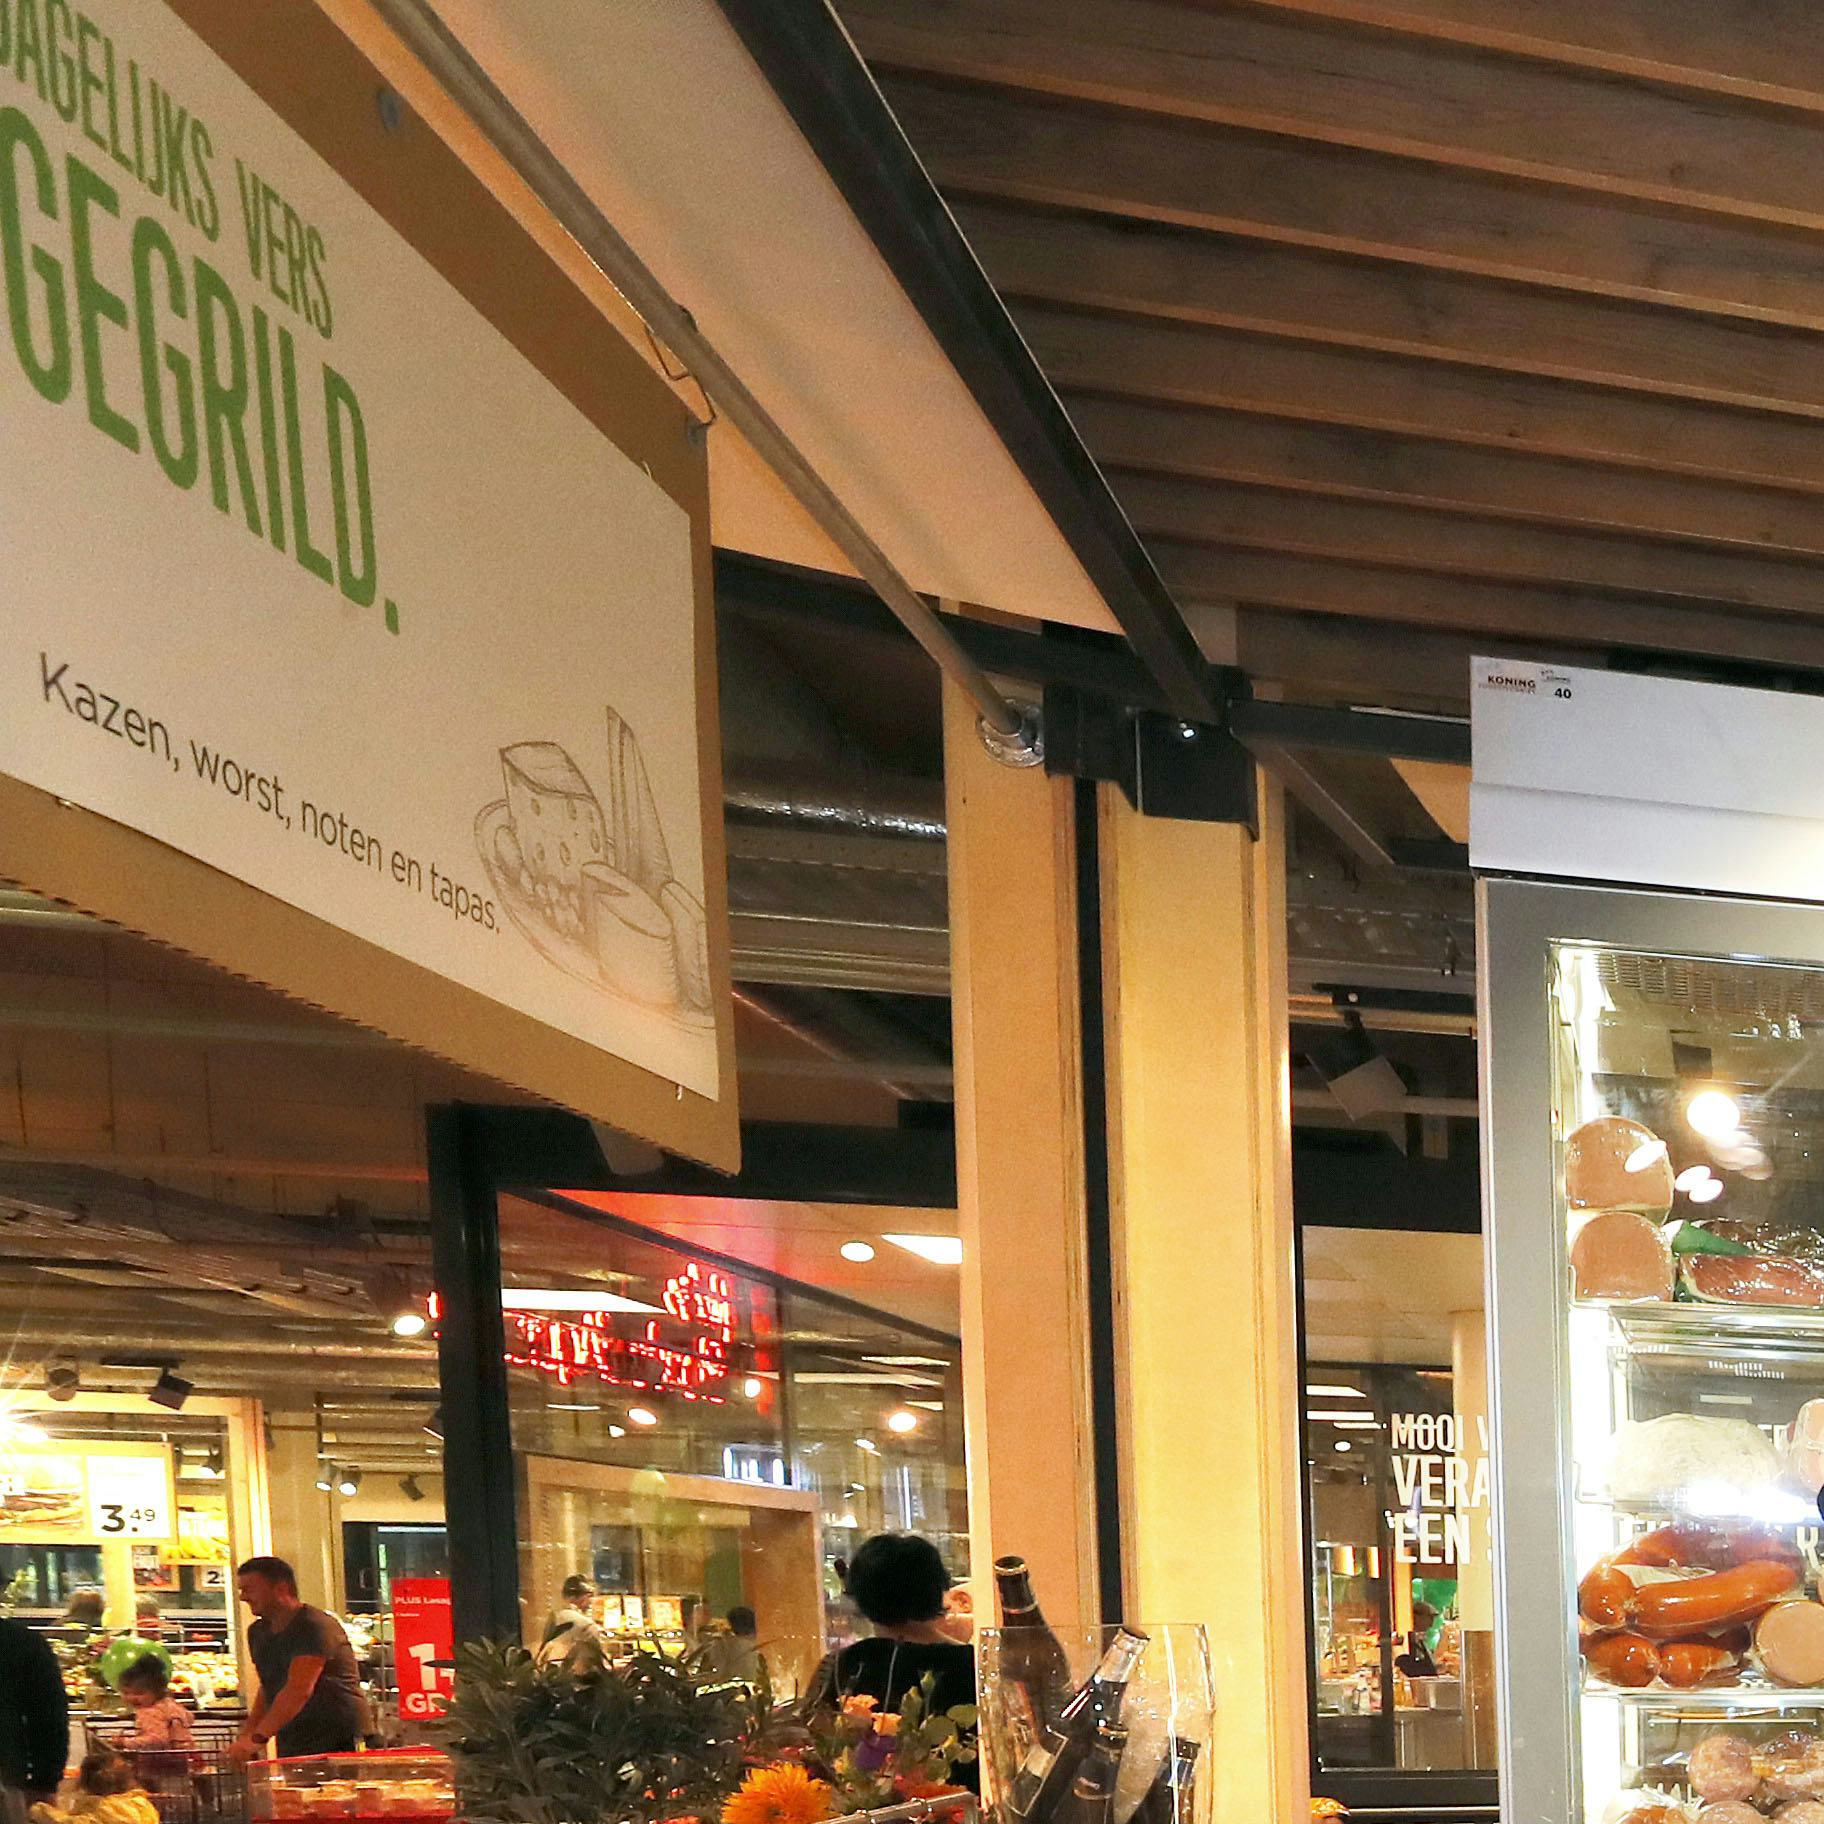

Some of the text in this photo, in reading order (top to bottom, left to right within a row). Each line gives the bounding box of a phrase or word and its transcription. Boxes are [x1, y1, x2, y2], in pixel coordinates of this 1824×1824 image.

[235, 157, 334, 340] VERS
[0, 106, 401, 636] GEGRILD.
[1487, 674, 1537, 689] KONING
[1554, 687, 1572, 699] 40
[39, 651, 501, 934] Kazen, worst, noten en tapas.
[100, 1504, 156, 1532] 3.49
[405, 1692, 457, 1714] GR
